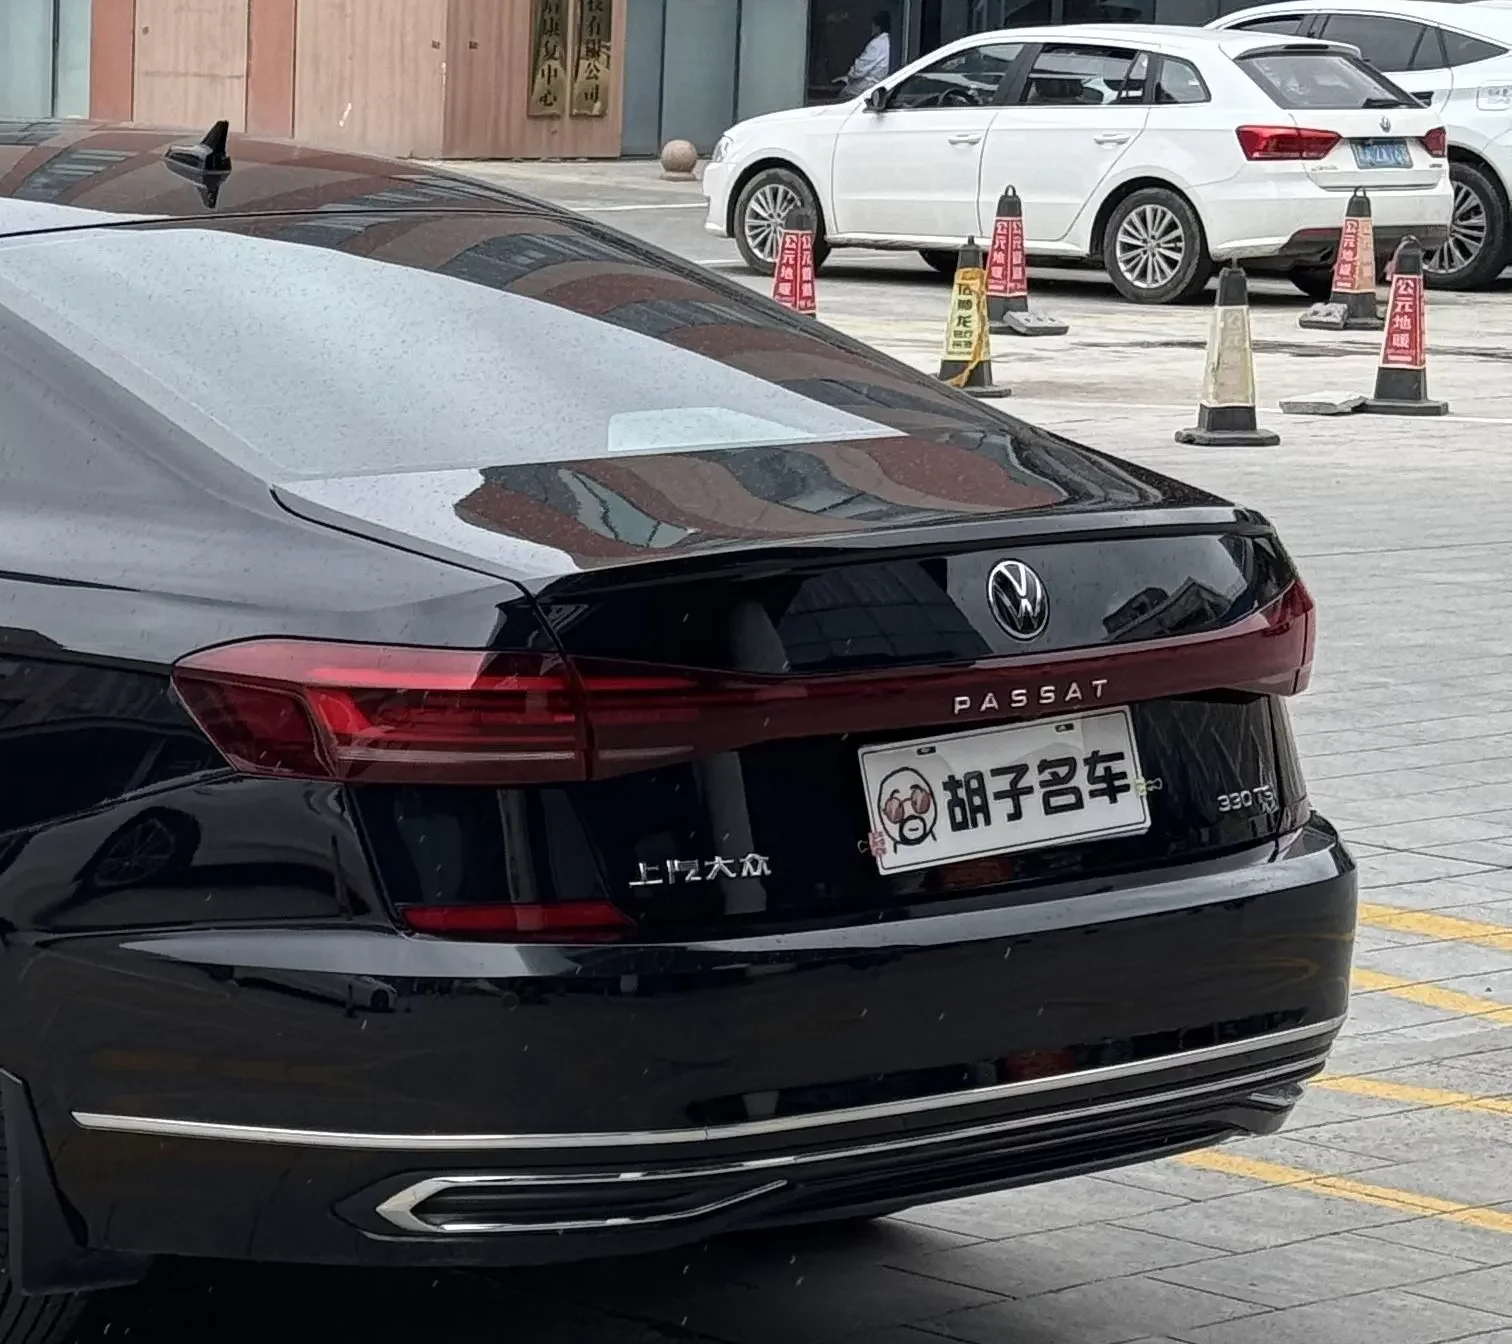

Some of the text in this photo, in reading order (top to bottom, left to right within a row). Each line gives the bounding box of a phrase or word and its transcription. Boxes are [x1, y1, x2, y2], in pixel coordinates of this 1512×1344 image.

[1391, 278, 1415, 350] 公元地暖
[953, 678, 1110, 714] PASSAT
[941, 749, 1131, 833] 胡子名车
[1217, 789, 1253, 813] 330
[628, 852, 773, 887] 上汽大众
